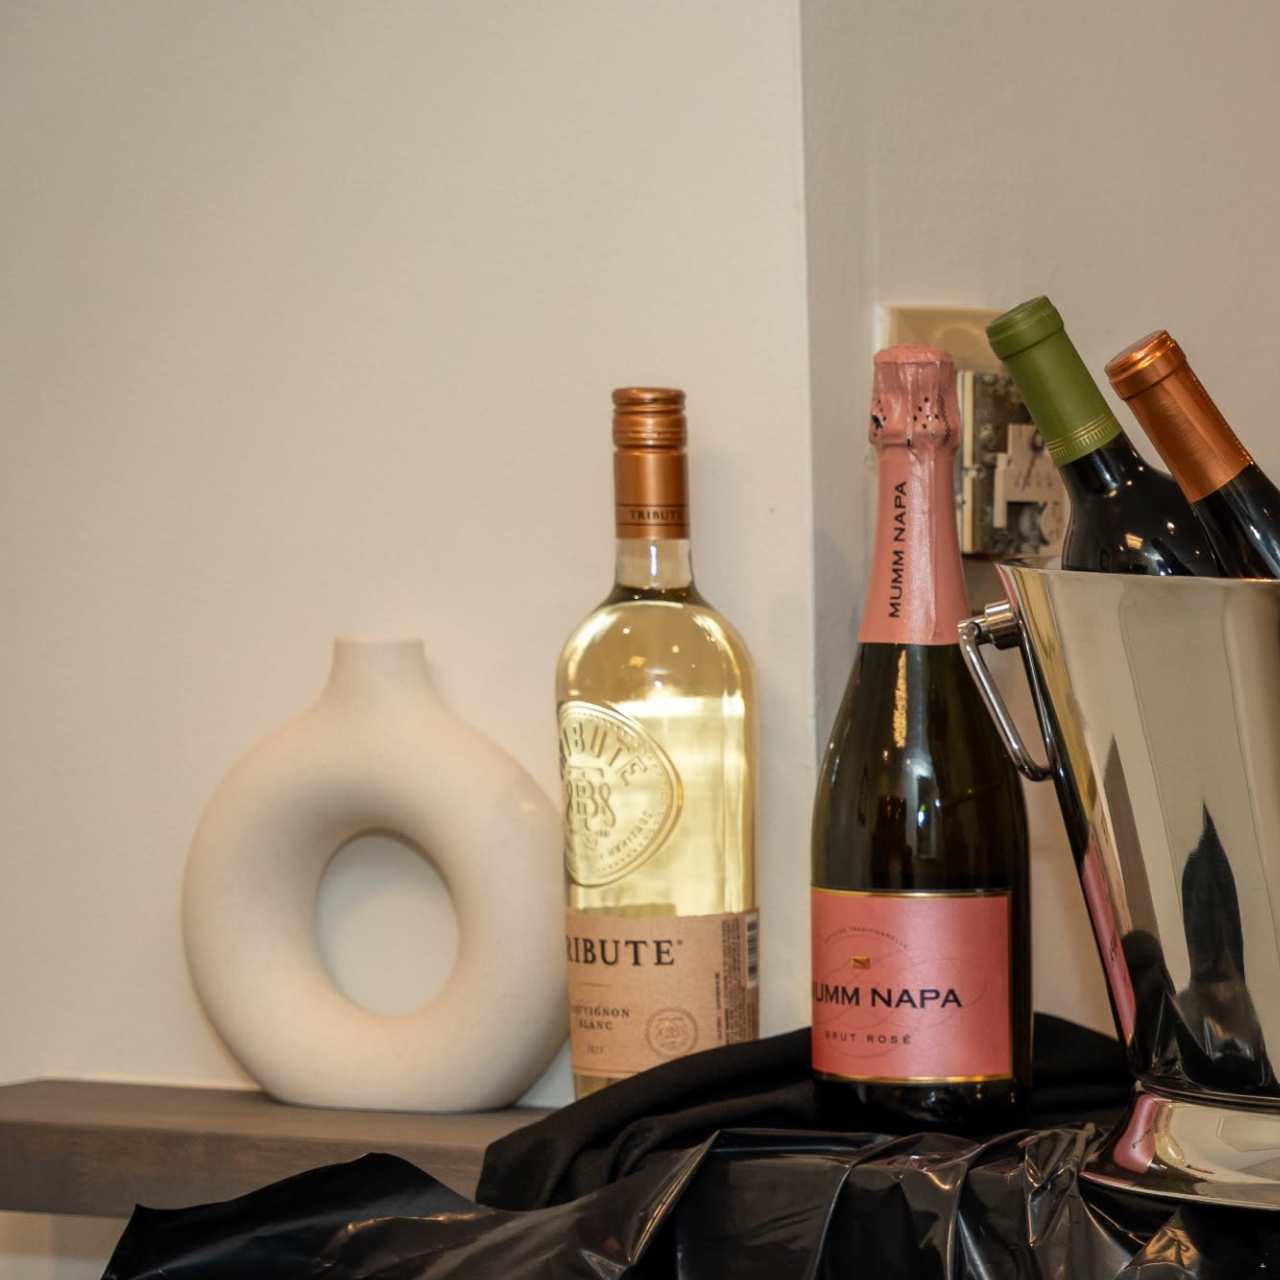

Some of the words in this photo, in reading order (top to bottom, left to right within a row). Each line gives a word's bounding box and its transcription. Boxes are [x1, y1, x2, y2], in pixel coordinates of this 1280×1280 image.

[894, 481, 907, 543] NAPA
[888, 551, 905, 619] MUMM
[565, 936, 676, 967] RIBUTE
[813, 982, 860, 1008] UMM
[870, 987, 963, 1008] NAPA
[824, 1030, 857, 1042] BRUT
[865, 1033, 913, 1046] ROSÉ
